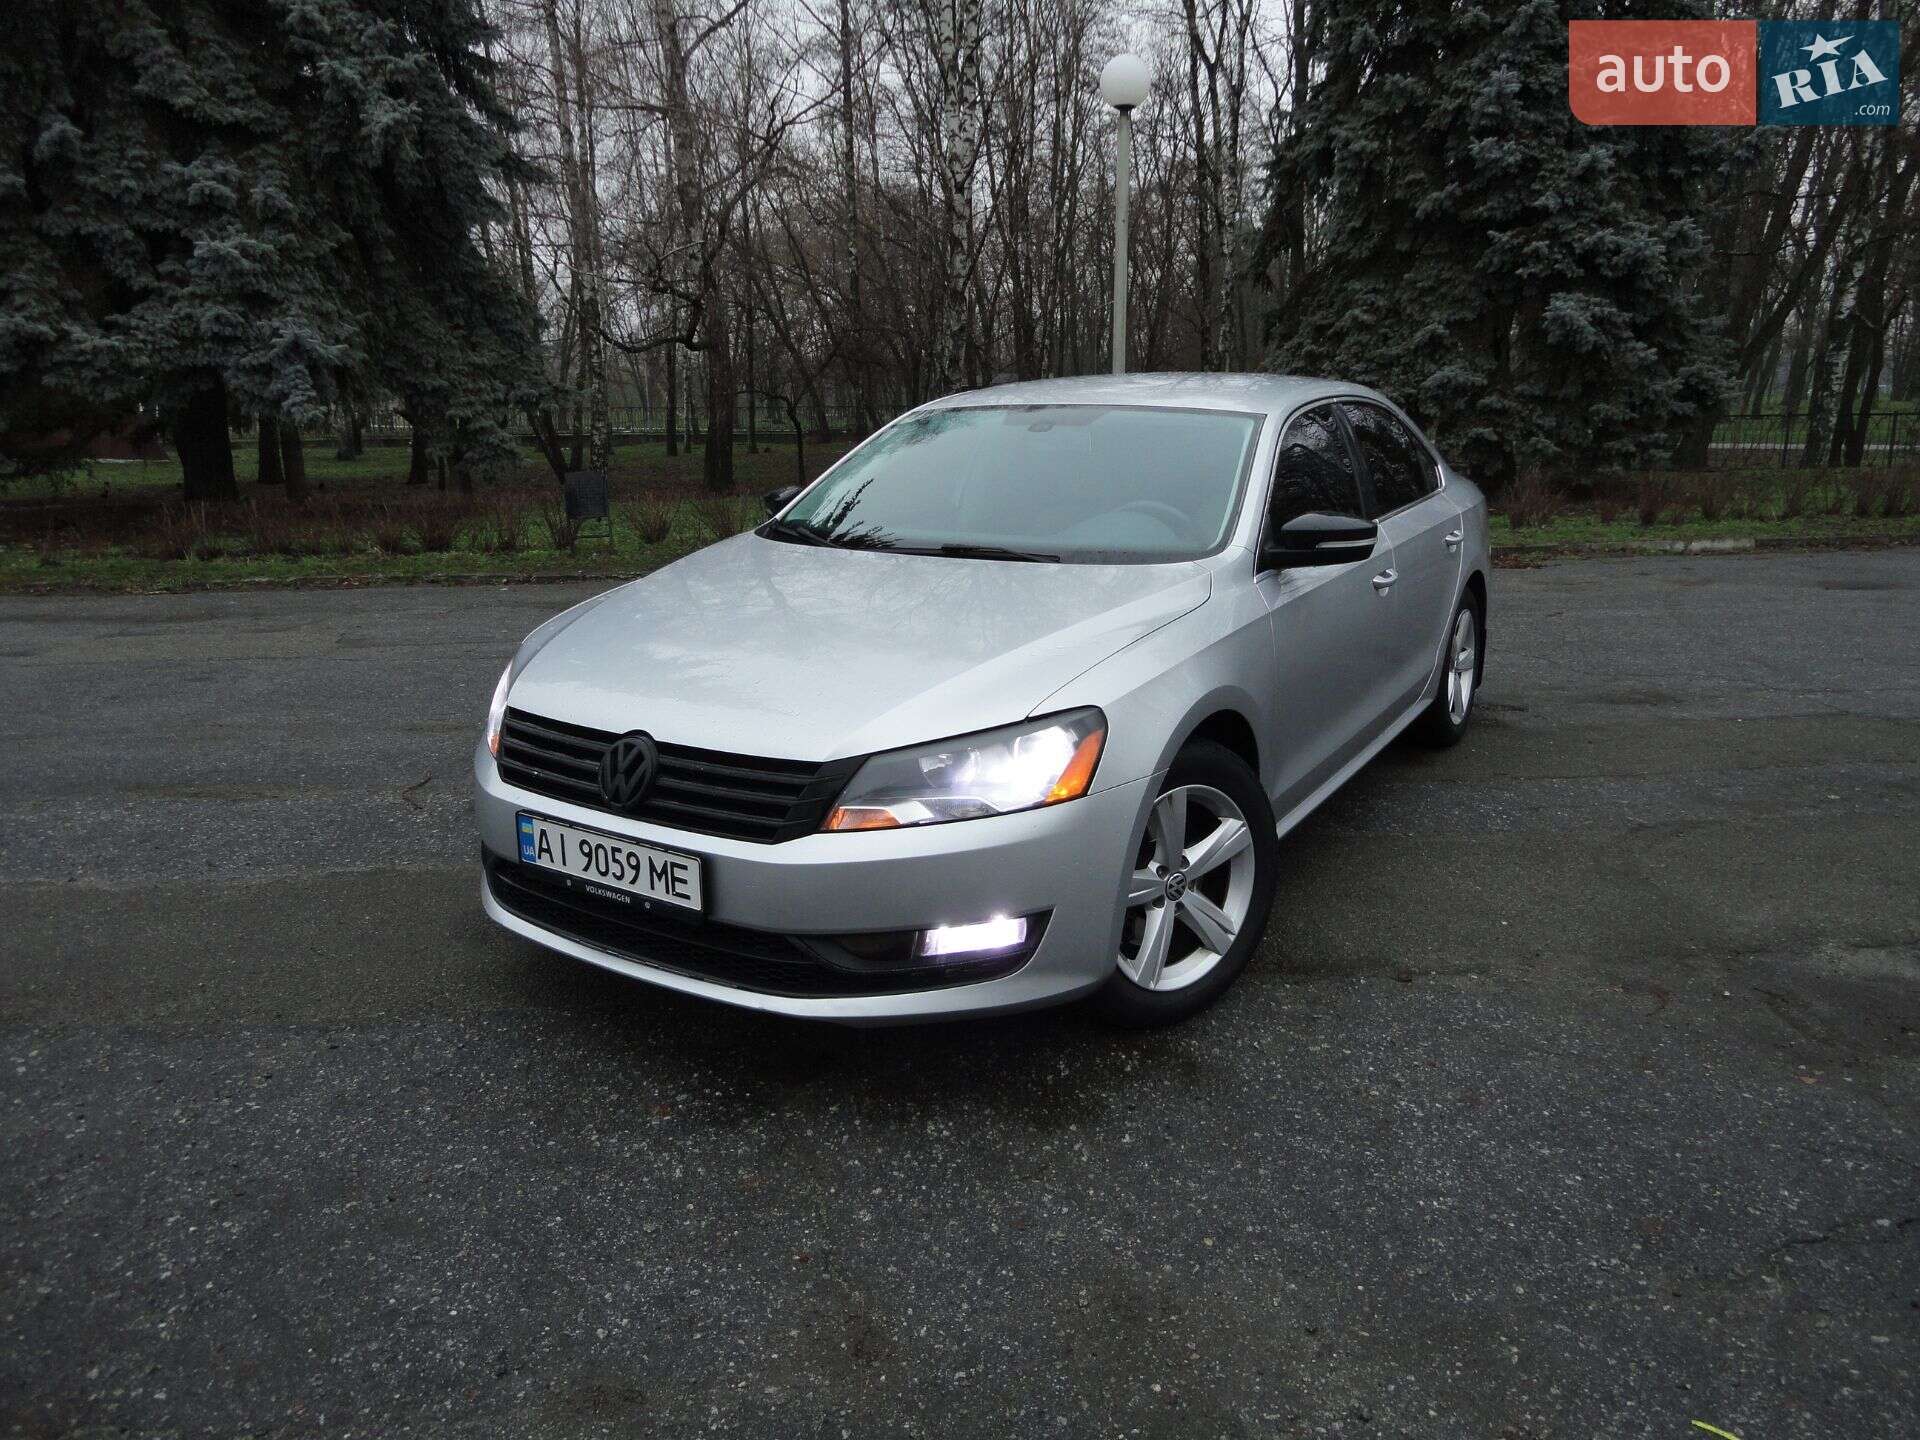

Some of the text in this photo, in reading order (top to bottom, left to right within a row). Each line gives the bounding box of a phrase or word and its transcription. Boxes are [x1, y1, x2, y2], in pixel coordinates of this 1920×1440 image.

[523, 846, 536, 857] UA
[537, 828, 691, 901] AI 9059 ME
[585, 884, 631, 904] VOLKSWAGEN
